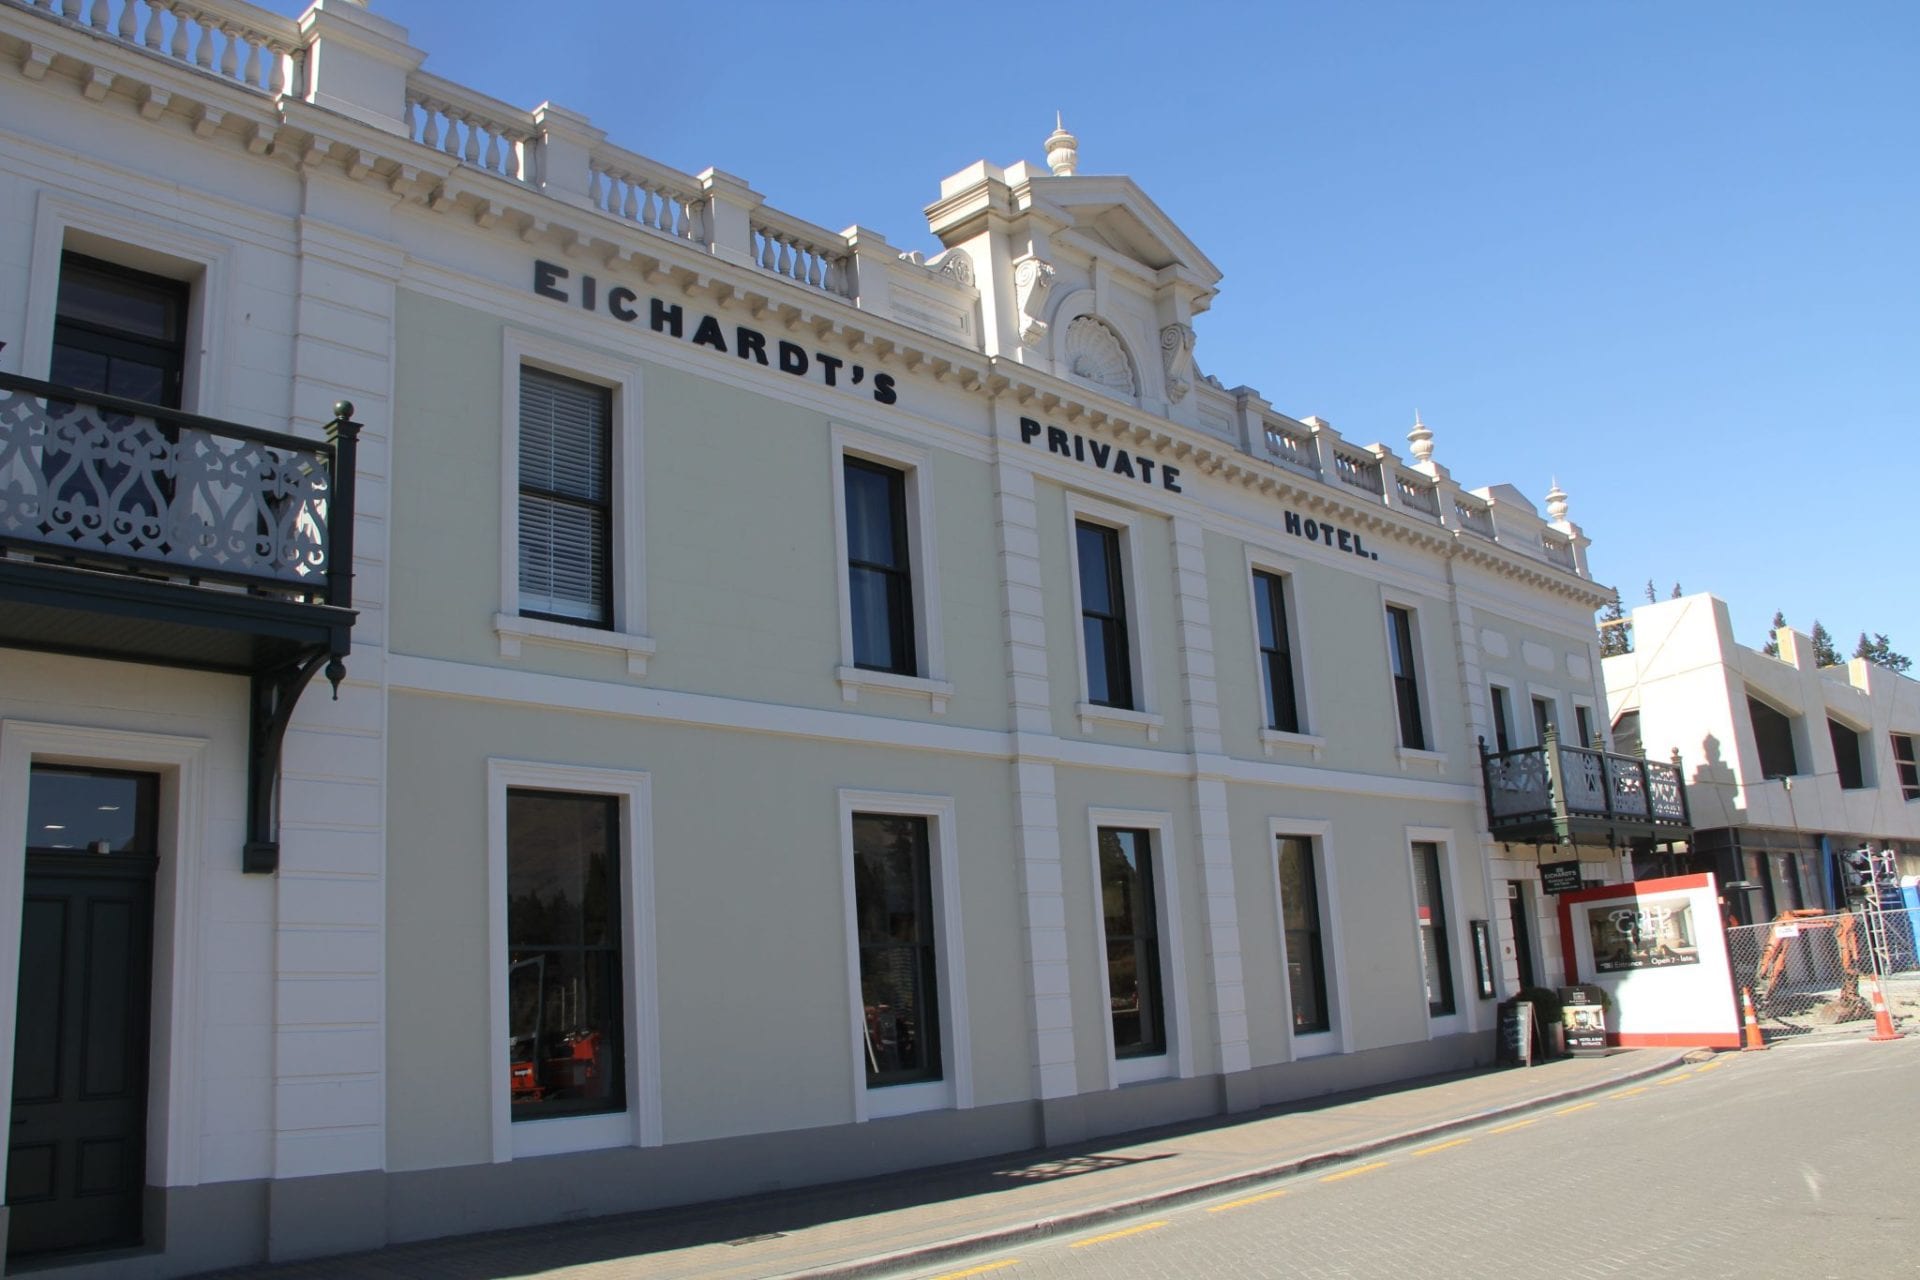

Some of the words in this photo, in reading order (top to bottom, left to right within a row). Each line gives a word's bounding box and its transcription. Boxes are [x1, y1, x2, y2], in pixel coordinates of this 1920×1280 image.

[534, 259, 898, 405] EICHARDT'S
[1020, 416, 1182, 493] PRIVATE
[1284, 510, 1378, 561] HOTEL.
[1651, 957, 1671, 965] Open
